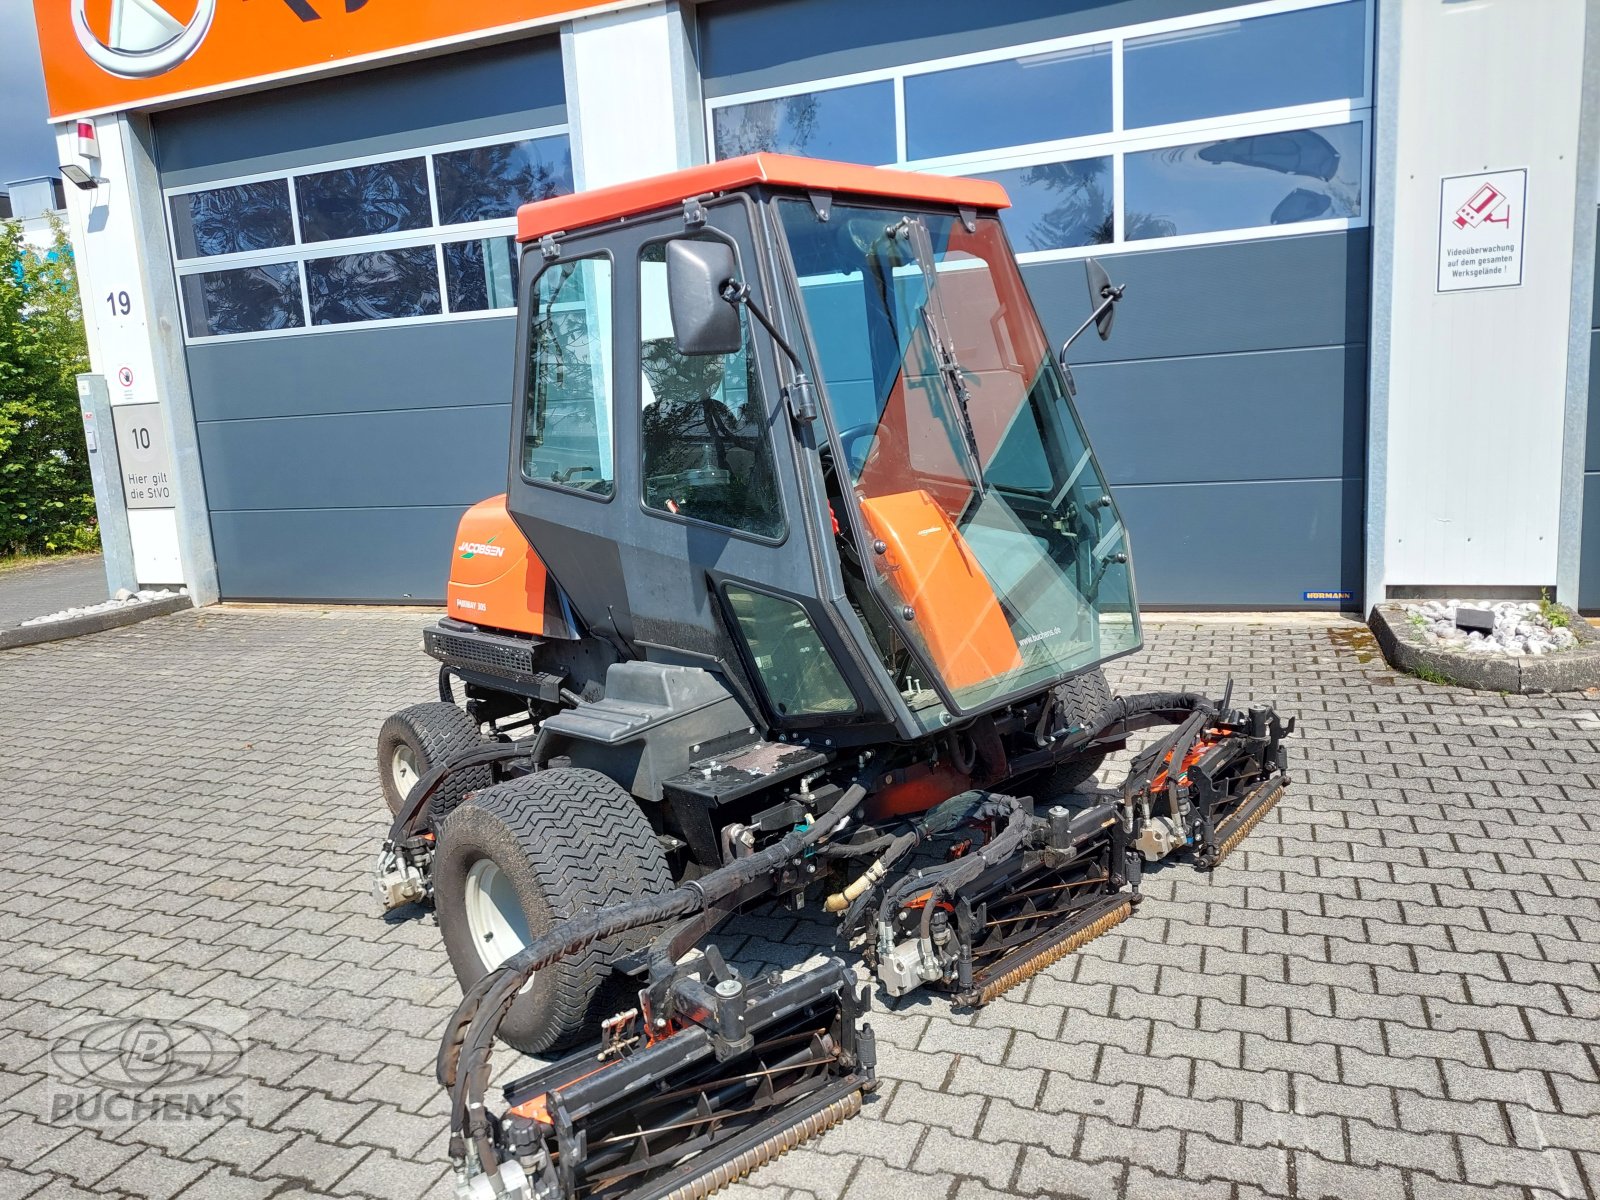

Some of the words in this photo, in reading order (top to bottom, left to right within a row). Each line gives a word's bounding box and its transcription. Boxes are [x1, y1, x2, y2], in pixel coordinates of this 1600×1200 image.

[1447, 244, 1515, 256] Videoüberwachung
[1447, 259, 1459, 268] auf
[1460, 257, 1476, 266] dem
[1478, 254, 1513, 266] gesamten
[1452, 267, 1502, 278] Werksgelände
[106, 290, 131, 316] 19
[131, 427, 151, 450] 10
[128, 473, 148, 484] Hier
[152, 472, 168, 485] gilt
[130, 489, 144, 499] die
[147, 487, 170, 499] StVO
[458, 542, 505, 557] JACOBSEN
[1018, 626, 1062, 647] www.buchens.de
